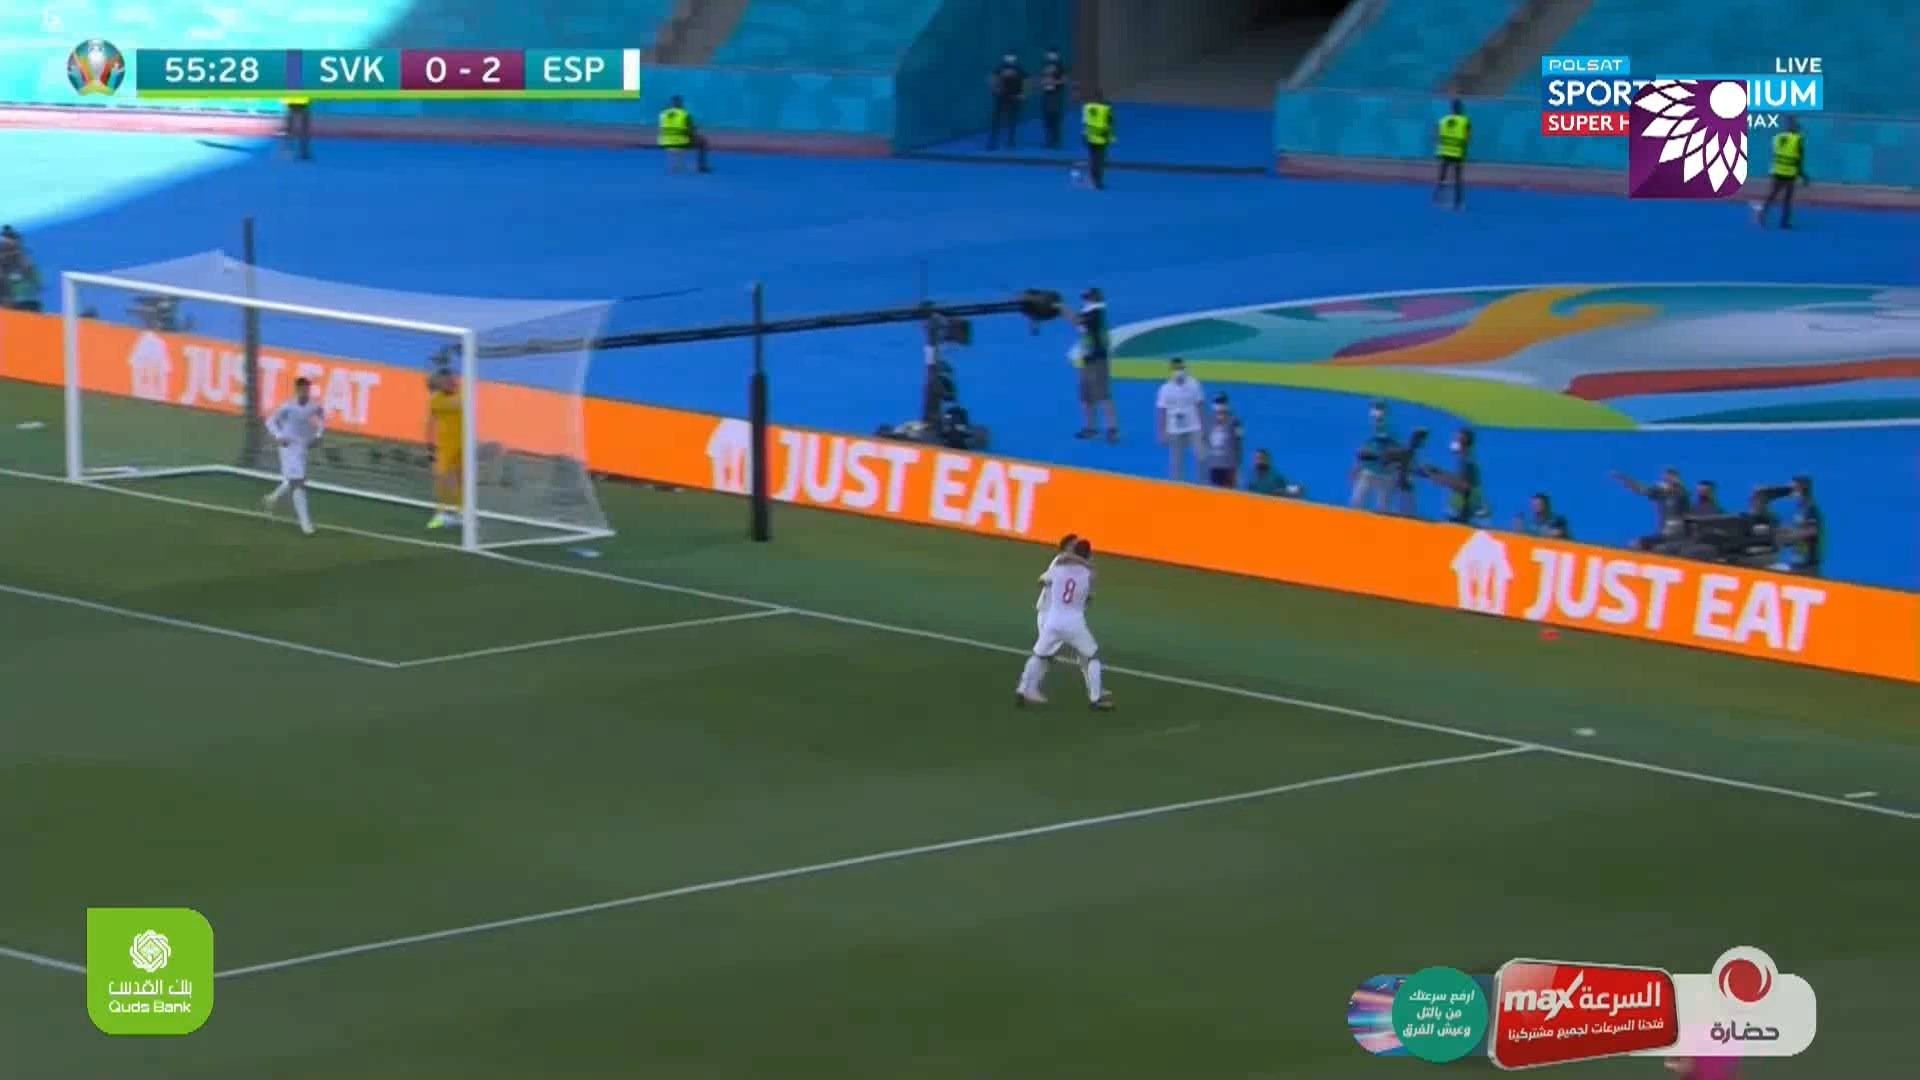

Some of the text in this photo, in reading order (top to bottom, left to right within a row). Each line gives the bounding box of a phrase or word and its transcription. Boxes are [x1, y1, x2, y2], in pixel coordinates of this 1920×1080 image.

[770, 428, 1050, 533] JUST EAT
[1063, 578, 1076, 603] 8
[1524, 548, 1827, 653] JUST EAT
